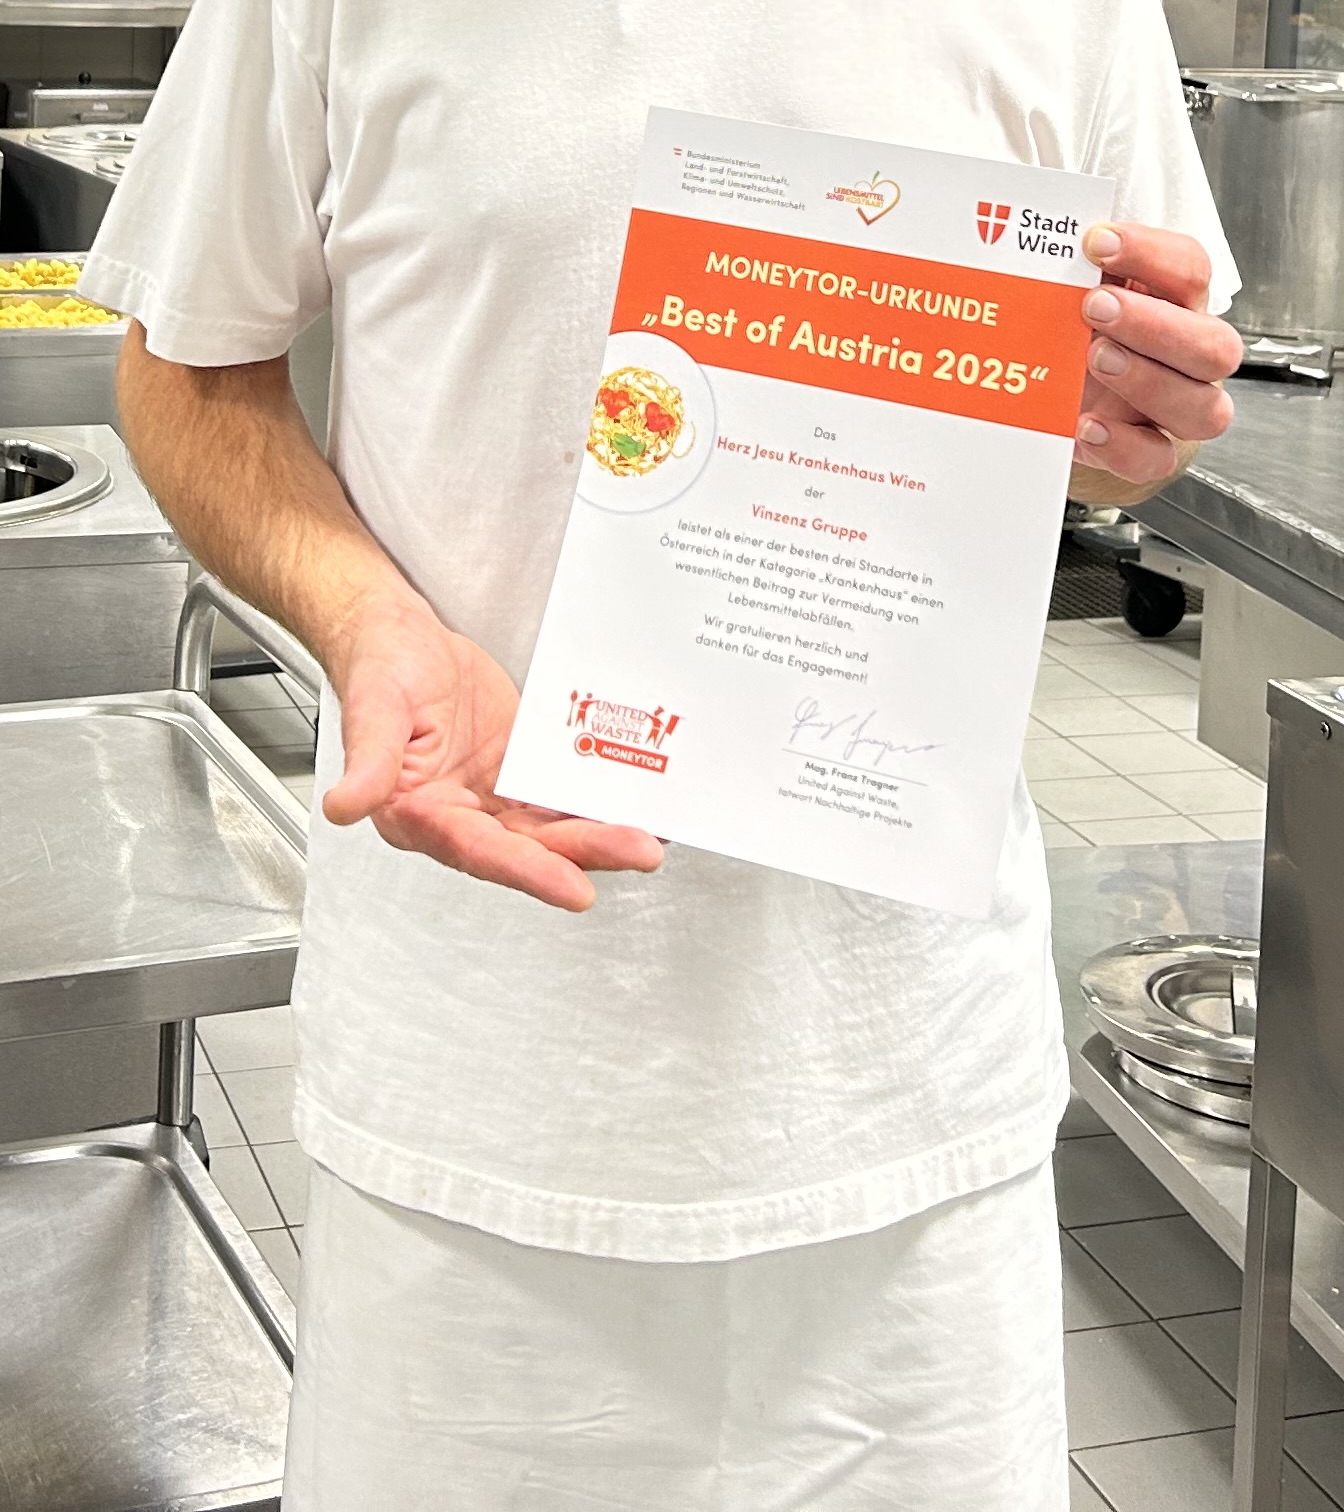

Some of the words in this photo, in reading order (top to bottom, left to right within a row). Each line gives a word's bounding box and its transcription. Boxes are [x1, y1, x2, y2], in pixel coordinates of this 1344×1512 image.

[687, 150, 761, 169] Bundesministerium
[737, 192, 805, 211] Wasserwirtschaft
[1020, 208, 1079, 236] Stadt
[1018, 231, 1074, 258] Wien
[704, 251, 999, 327] MONEYTOR-URKUNDE
[641, 294, 738, 338] „Best
[746, 315, 786, 347] of
[789, 320, 923, 375] Austria
[933, 348, 1049, 395] 2025“
[814, 426, 837, 441] Das
[717, 436, 751, 454] Herz
[752, 444, 784, 462] Jesu
[788, 450, 885, 483] Krankenhaus
[889, 472, 926, 492] Wien
[804, 486, 826, 499] der
[752, 504, 808, 528] Vinzenz
[812, 518, 868, 542] Gruppe
[678, 518, 712, 536] leistet
[714, 528, 730, 541] als
[734, 532, 764, 548] einer
[766, 539, 787, 553] der
[789, 543, 829, 563] besten
[832, 554, 856, 569] drei
[858, 559, 919, 584] Standorte
[922, 573, 933, 586] in
[660, 532, 720, 559] Österreich
[722, 548, 733, 561] in
[736, 552, 756, 567] der
[759, 558, 817, 582] Kategorie
[910, 592, 944, 609] einen
[675, 561, 749, 586] wesentlichen
[752, 576, 796, 599] Beitrag
[798, 589, 818, 602] zur
[822, 592, 894, 621] Vermeidung
[896, 611, 919, 625] von
[728, 592, 854, 632] Lebensmittelabfällen.
[704, 614, 724, 627] Wir
[726, 620, 792, 646] gratulieren
[795, 635, 842, 658] herzlich
[845, 648, 868, 663] und
[695, 633, 739, 654] danken
[742, 644, 760, 658] für
[762, 650, 784, 664] das
[787, 655, 869, 684] Engagement!
[592, 712, 646, 731] AGAINST
[596, 700, 648, 722] UNITED
[592, 720, 642, 744] WASTE
[601, 745, 664, 770] MONEYTOR
[804, 760, 828, 776] Mag.
[831, 768, 858, 783] Franz
[798, 776, 828, 791] United
[830, 784, 866, 800] Against
[814, 796, 871, 818] Nachhaltige
[873, 810, 913, 828] Projekte
